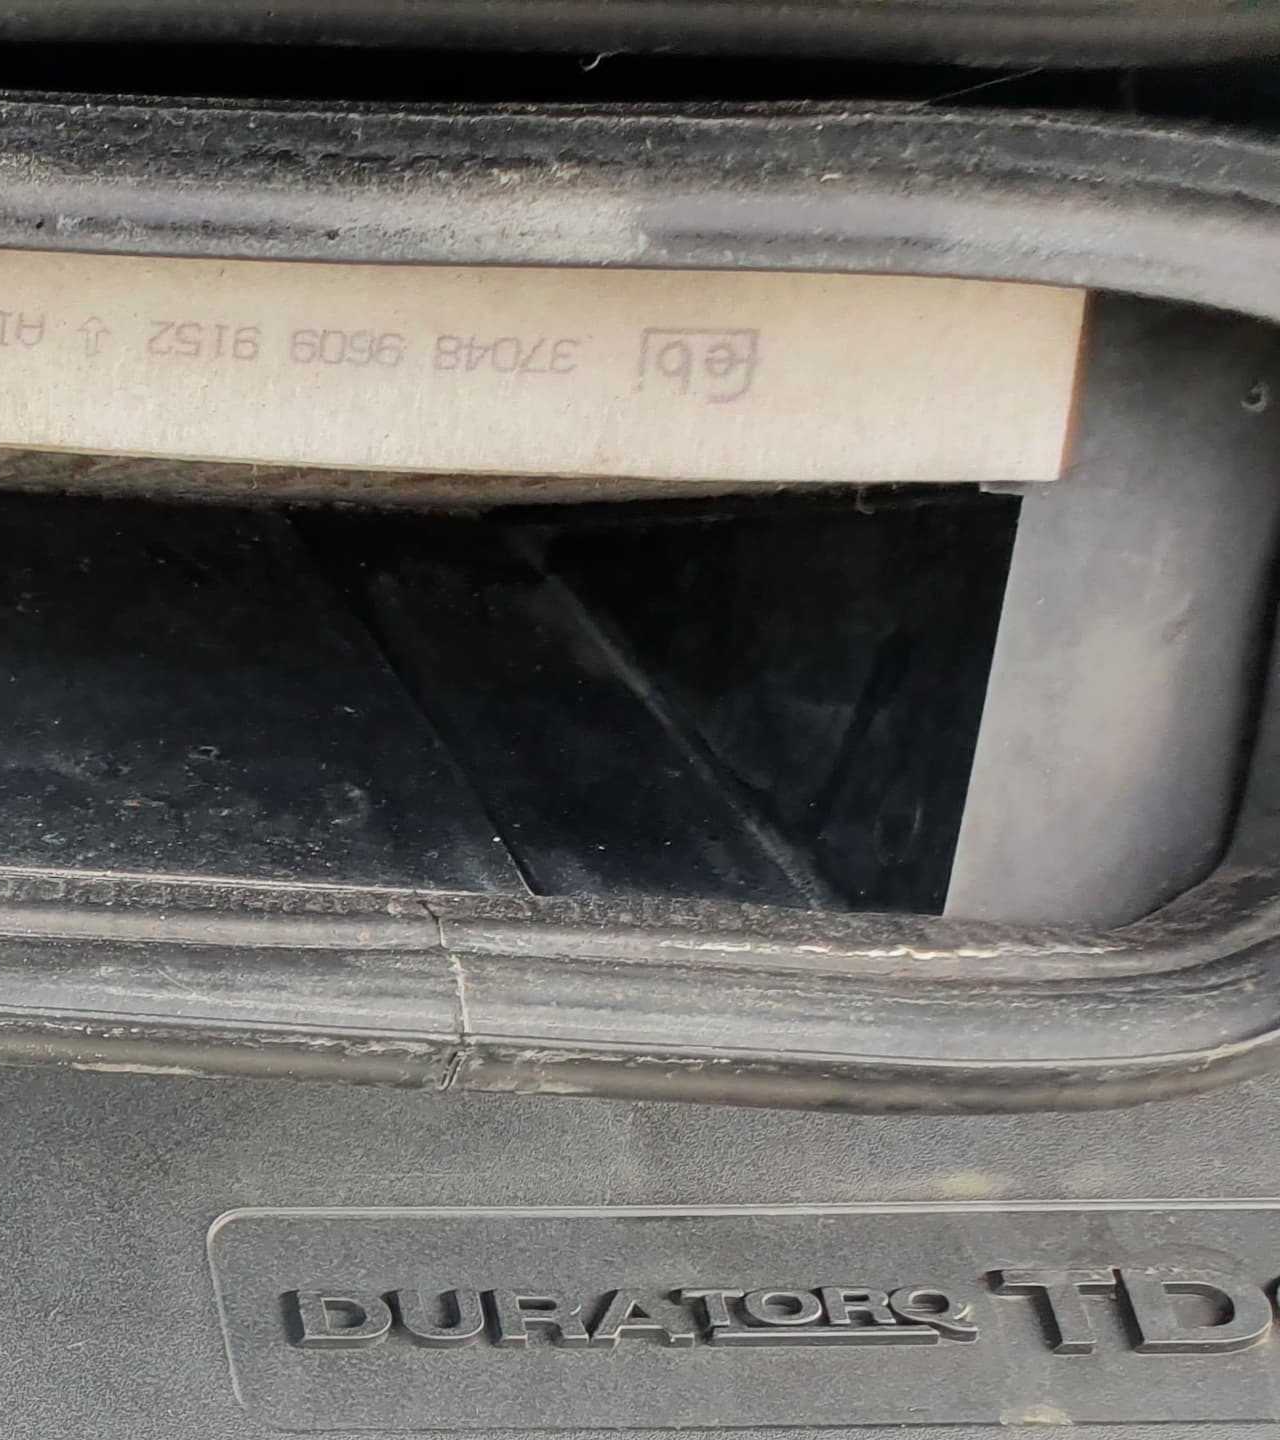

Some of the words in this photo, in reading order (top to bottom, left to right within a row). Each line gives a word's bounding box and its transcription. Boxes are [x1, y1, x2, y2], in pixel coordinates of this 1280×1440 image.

[148, 320, 262, 361] 9152
[290, 329, 405, 369] 9609
[434, 335, 581, 375] 37048
[279, 1287, 980, 1349] DURATORQ
[988, 1268, 1280, 1356] TD
